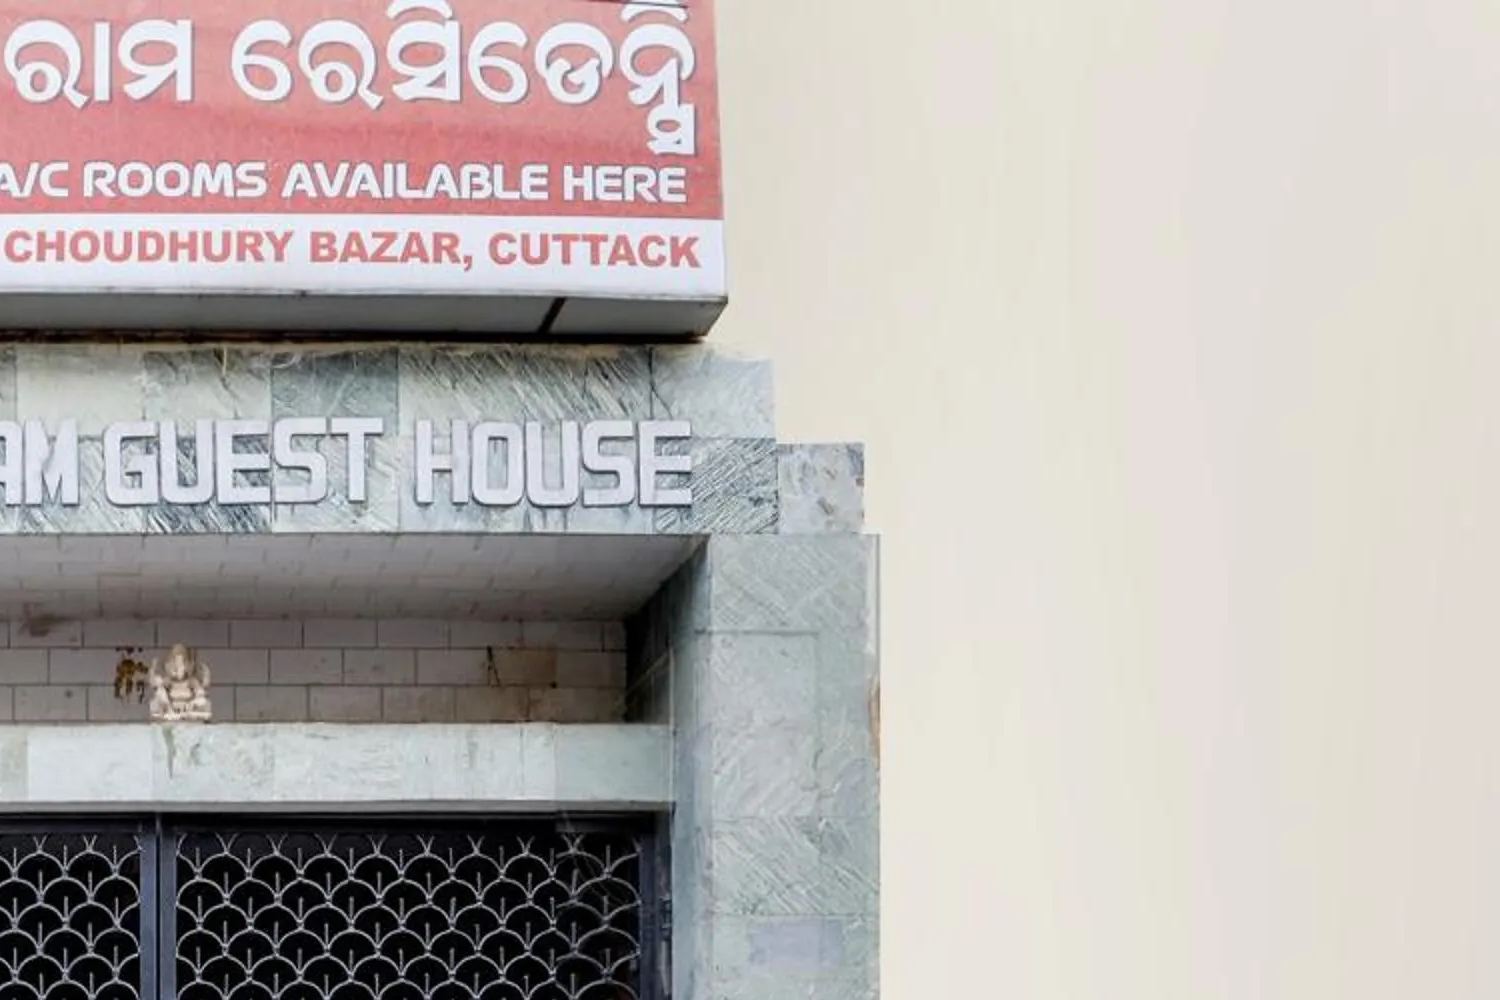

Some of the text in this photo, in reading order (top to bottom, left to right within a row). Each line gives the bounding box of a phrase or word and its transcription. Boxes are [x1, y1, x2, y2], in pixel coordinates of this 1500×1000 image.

[3, 19, 194, 109] ରାମ
[82, 161, 267, 198] ROOMS
[281, 162, 550, 200] AVAILABLE
[562, 164, 687, 203] HERE
[3, 229, 294, 263] CHOUDHURY
[309, 230, 474, 273] BAZAR,
[488, 232, 702, 268] CUTTACK
[104, 418, 383, 506] GUEST
[415, 420, 693, 508] HOUSE
